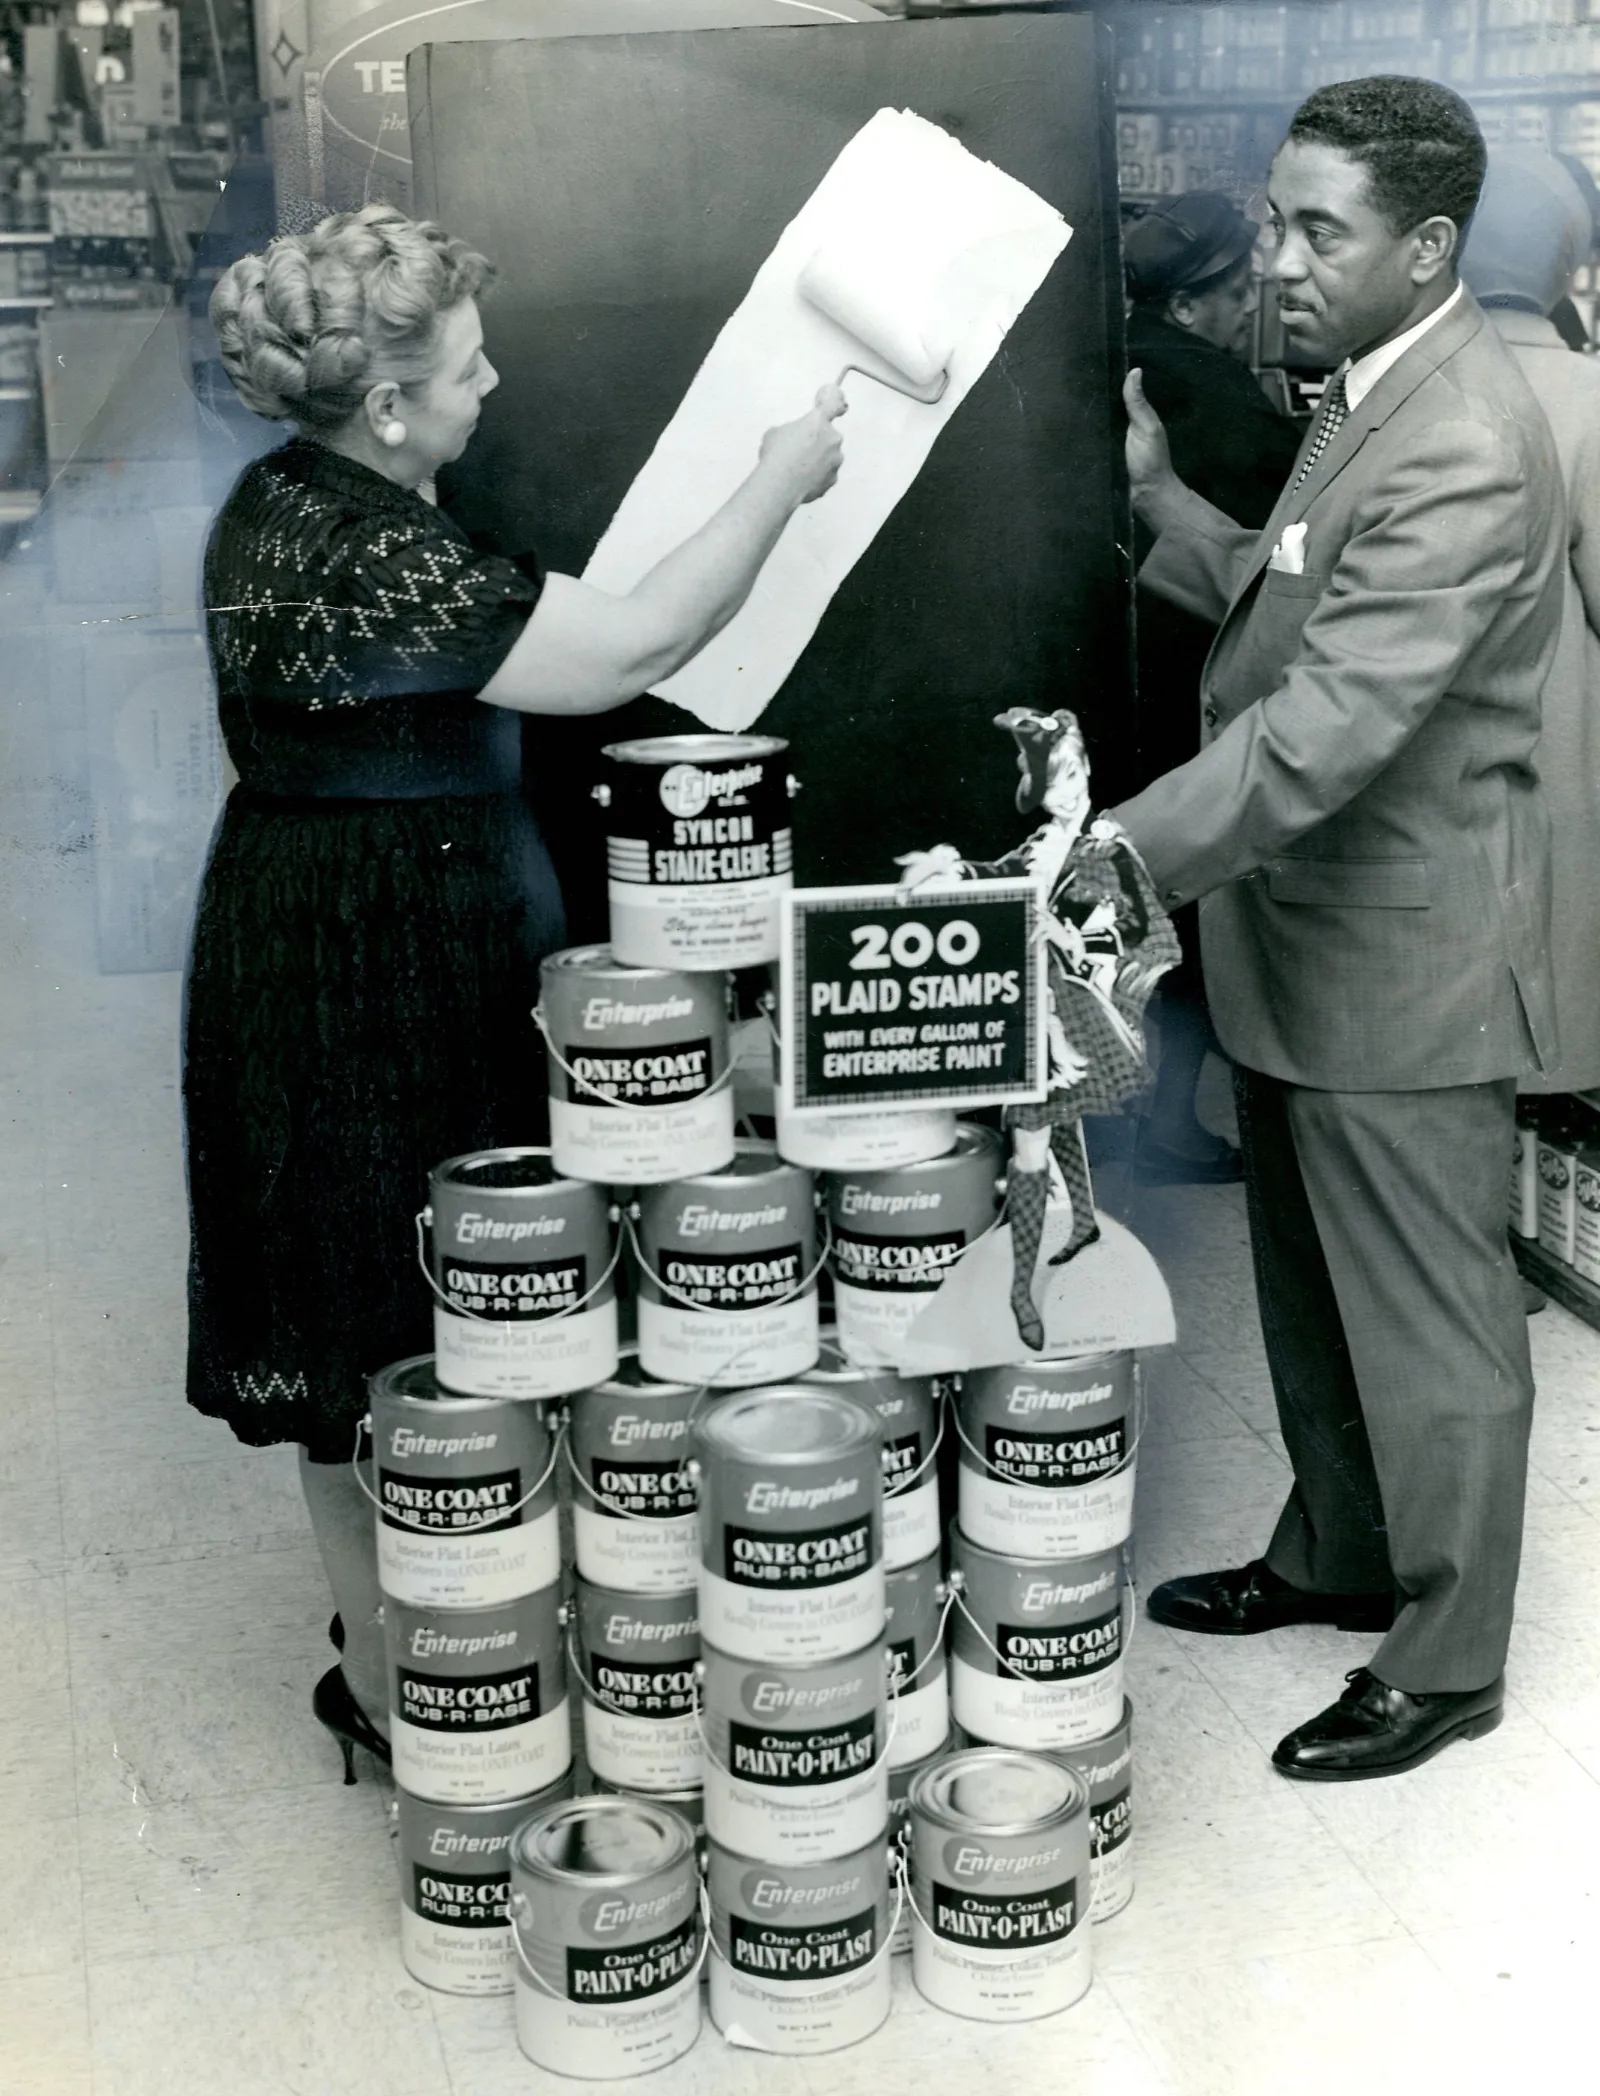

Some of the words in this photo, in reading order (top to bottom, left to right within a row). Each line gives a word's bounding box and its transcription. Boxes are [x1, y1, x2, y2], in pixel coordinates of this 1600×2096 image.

[849, 920, 980, 970] 200
[811, 979, 902, 1016] PLAID
[908, 970, 1020, 1011] STAMPS
[584, 995, 694, 1031] Enterprise
[823, 1030, 865, 1049] WITH
[870, 1026, 917, 1047] EVERY
[920, 1021, 979, 1042] GALLON
[985, 1020, 1006, 1038] OF
[823, 1047, 940, 1079] ENTERPRISE
[946, 1043, 1006, 1070] PAINT
[841, 1184, 941, 1215] Enterprise
[456, 1212, 566, 1244] Enterprise
[679, 1204, 788, 1237] Enterprise
[392, 1427, 498, 1458] Enterprise
[747, 1476, 859, 1513] Enterprise
[411, 1628, 518, 1657] Enterprise
[753, 1678, 863, 1712] Enterprise
[761, 1736, 803, 1750] One
[807, 1732, 850, 1749] Coat
[954, 1846, 1061, 1876] Enterprise
[752, 1876, 860, 1908] Enterprise
[962, 1899, 1002, 1913] One
[1006, 1899, 1051, 1914] Coat
[760, 1931, 800, 1946] One
[805, 1928, 850, 1945] Coat
[604, 1953, 644, 1967] One
